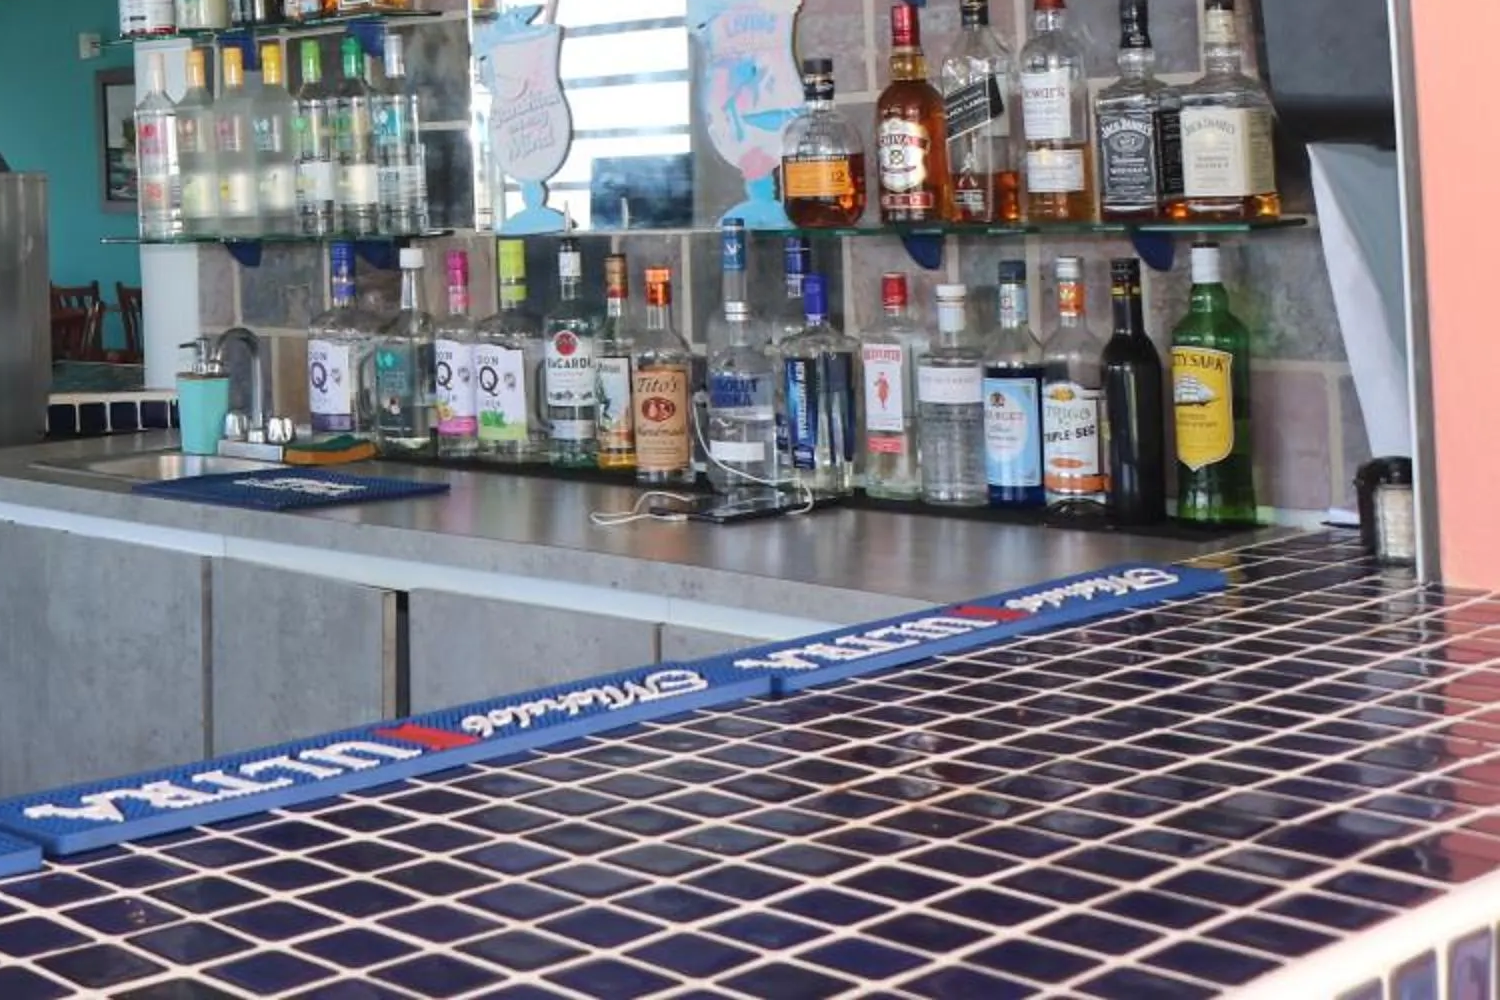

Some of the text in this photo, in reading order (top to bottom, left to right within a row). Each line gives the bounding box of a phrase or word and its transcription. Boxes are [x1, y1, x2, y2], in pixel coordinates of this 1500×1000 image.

[310, 361, 328, 393] Q
[436, 361, 453, 391] Q
[479, 365, 499, 397] Q
[637, 377, 680, 393] Tito's
[24, 740, 422, 823] ULTRA
